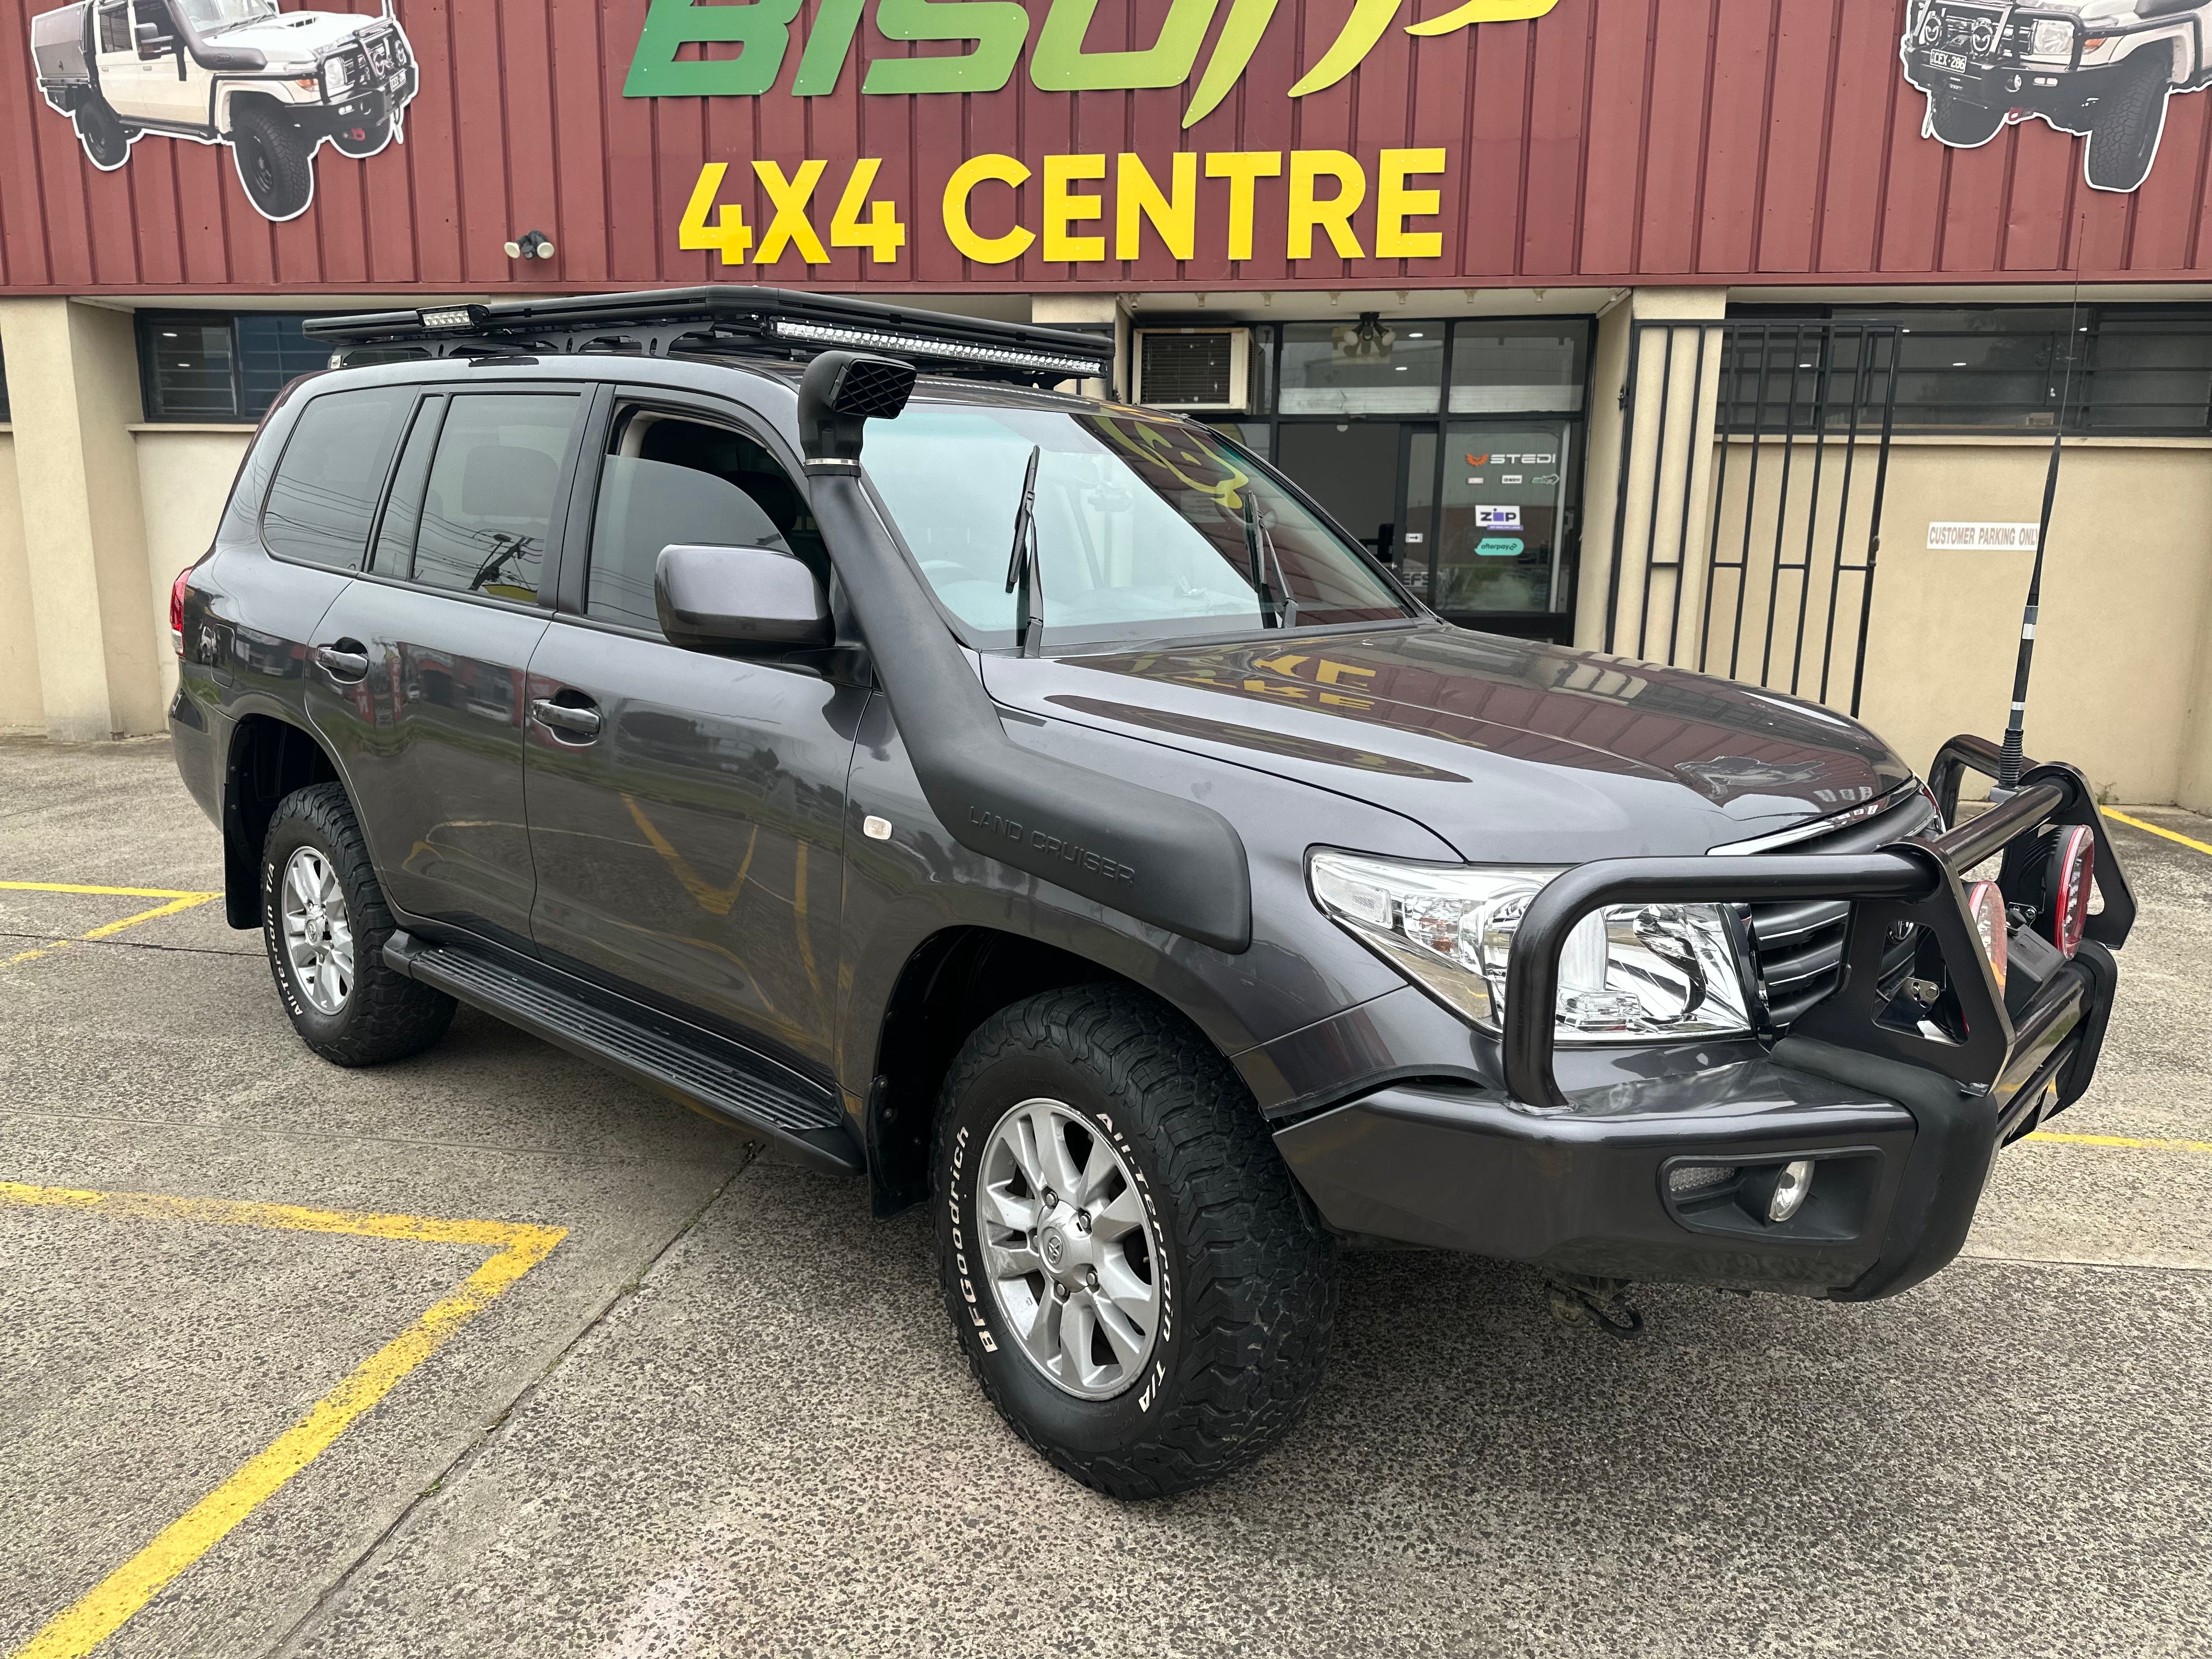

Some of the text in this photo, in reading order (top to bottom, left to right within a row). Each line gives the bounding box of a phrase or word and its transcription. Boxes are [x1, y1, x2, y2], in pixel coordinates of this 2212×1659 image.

[679, 148, 1446, 266] 4X4 CENTRE
[1490, 453, 1556, 464] STEDI
[1929, 526, 1975, 545] CUSTOMER
[1978, 527, 2015, 545] PARKING
[266, 862, 275, 893] T/A
[969, 806, 1135, 885] LAND CRUISER
[950, 1126, 998, 1353] BFGoodrich
[1096, 1113, 1174, 1413] All-Terrain T/A
